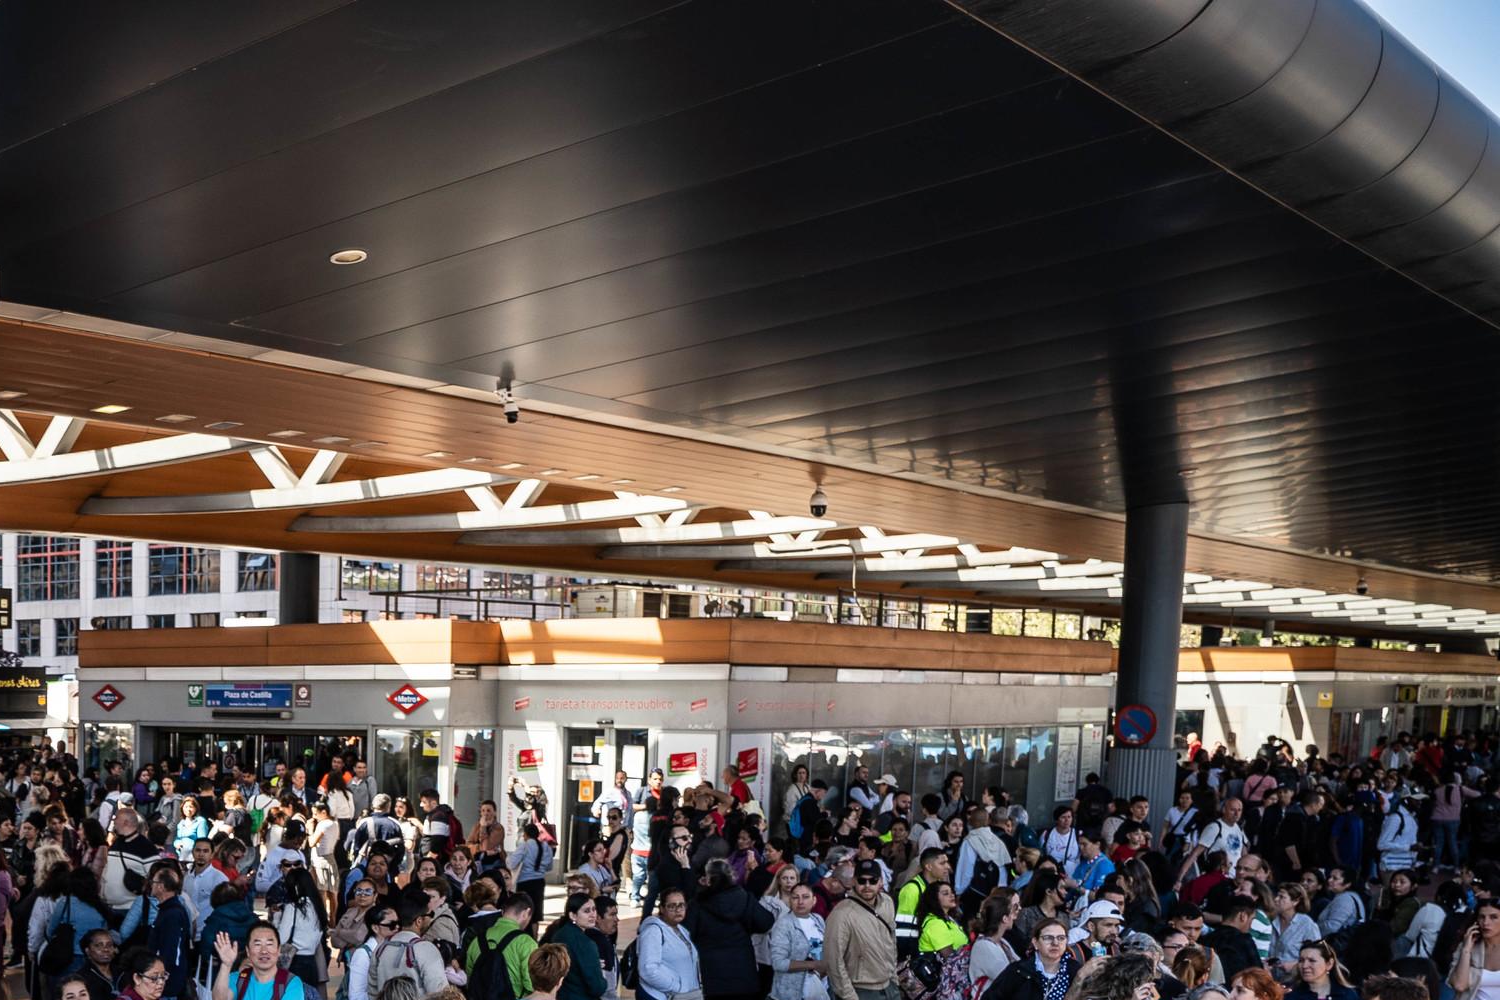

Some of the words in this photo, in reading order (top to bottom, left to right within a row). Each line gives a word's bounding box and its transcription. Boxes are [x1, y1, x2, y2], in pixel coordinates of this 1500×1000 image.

[224, 691, 240, 699] Plaza
[241, 691, 248, 699] de
[249, 691, 272, 699] Castilla
[397, 694, 417, 704] Metro
